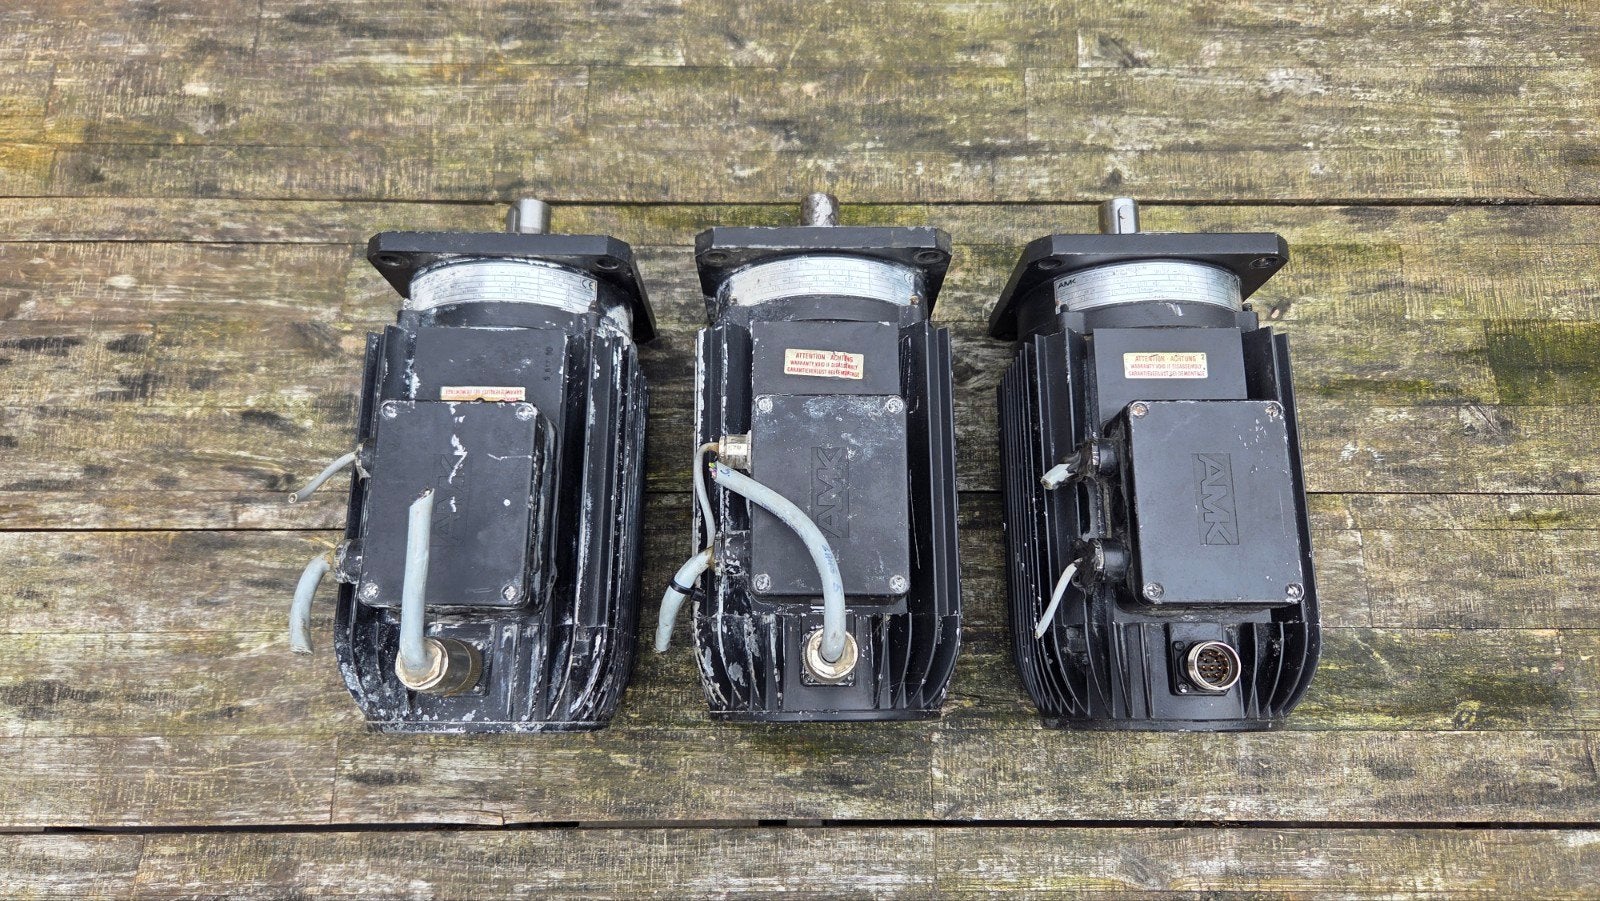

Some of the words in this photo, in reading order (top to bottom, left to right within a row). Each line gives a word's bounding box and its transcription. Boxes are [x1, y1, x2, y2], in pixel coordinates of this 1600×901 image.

[1057, 277, 1076, 290] AMK
[816, 447, 846, 538] AMK
[1198, 453, 1233, 545] AMK
